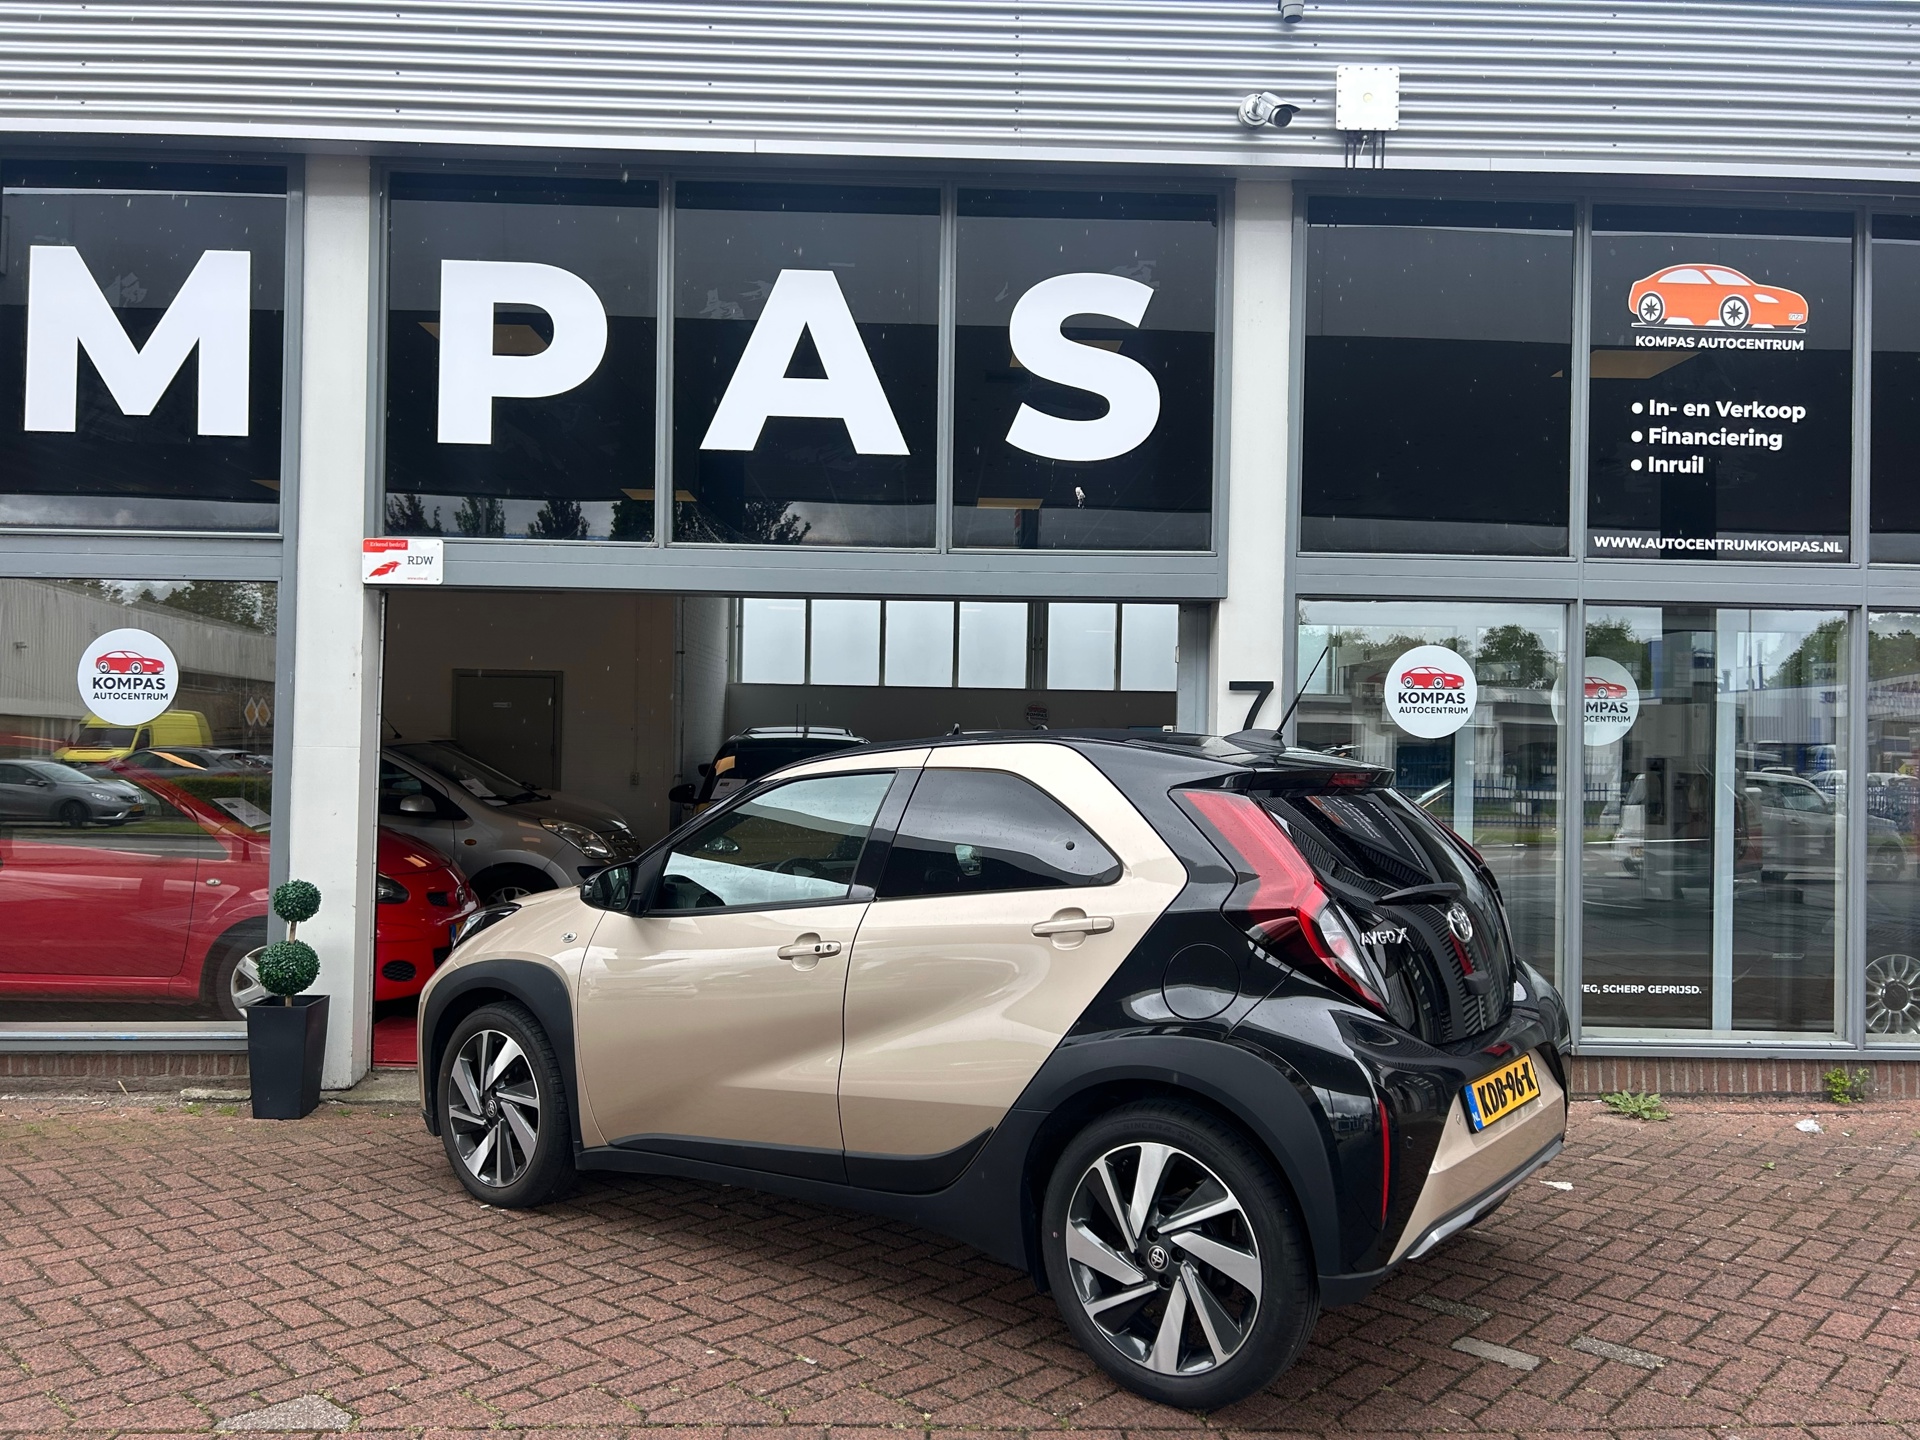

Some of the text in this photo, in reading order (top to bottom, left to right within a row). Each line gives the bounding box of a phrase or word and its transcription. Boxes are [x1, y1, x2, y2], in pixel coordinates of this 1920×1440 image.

[1635, 335, 1805, 351] KOMPAS AUTOCENTRUM
[1649, 399, 1807, 423] In- en Verkoop
[1649, 426, 1783, 451] Financiering
[1648, 455, 1705, 474] Inruil
[1593, 536, 1844, 553] WWW.AUTOCENTRUMKOMPAS.NL
[407, 555, 434, 566] RDW
[92, 677, 166, 690] KOMPAS
[93, 692, 169, 701] AUTOCENTRUM
[1397, 691, 1466, 704] KOMPAS
[1229, 681, 1274, 731] 7
[1398, 706, 1469, 715] AUTOCENTRUM
[1585, 701, 1629, 713] MPAS
[1583, 715, 1631, 723] OCENTRUM
[1602, 984, 1646, 994] SCHERP
[1647, 985, 1702, 995] GEPRIJSD.
[1477, 1061, 1536, 1118] KDB-96-K
